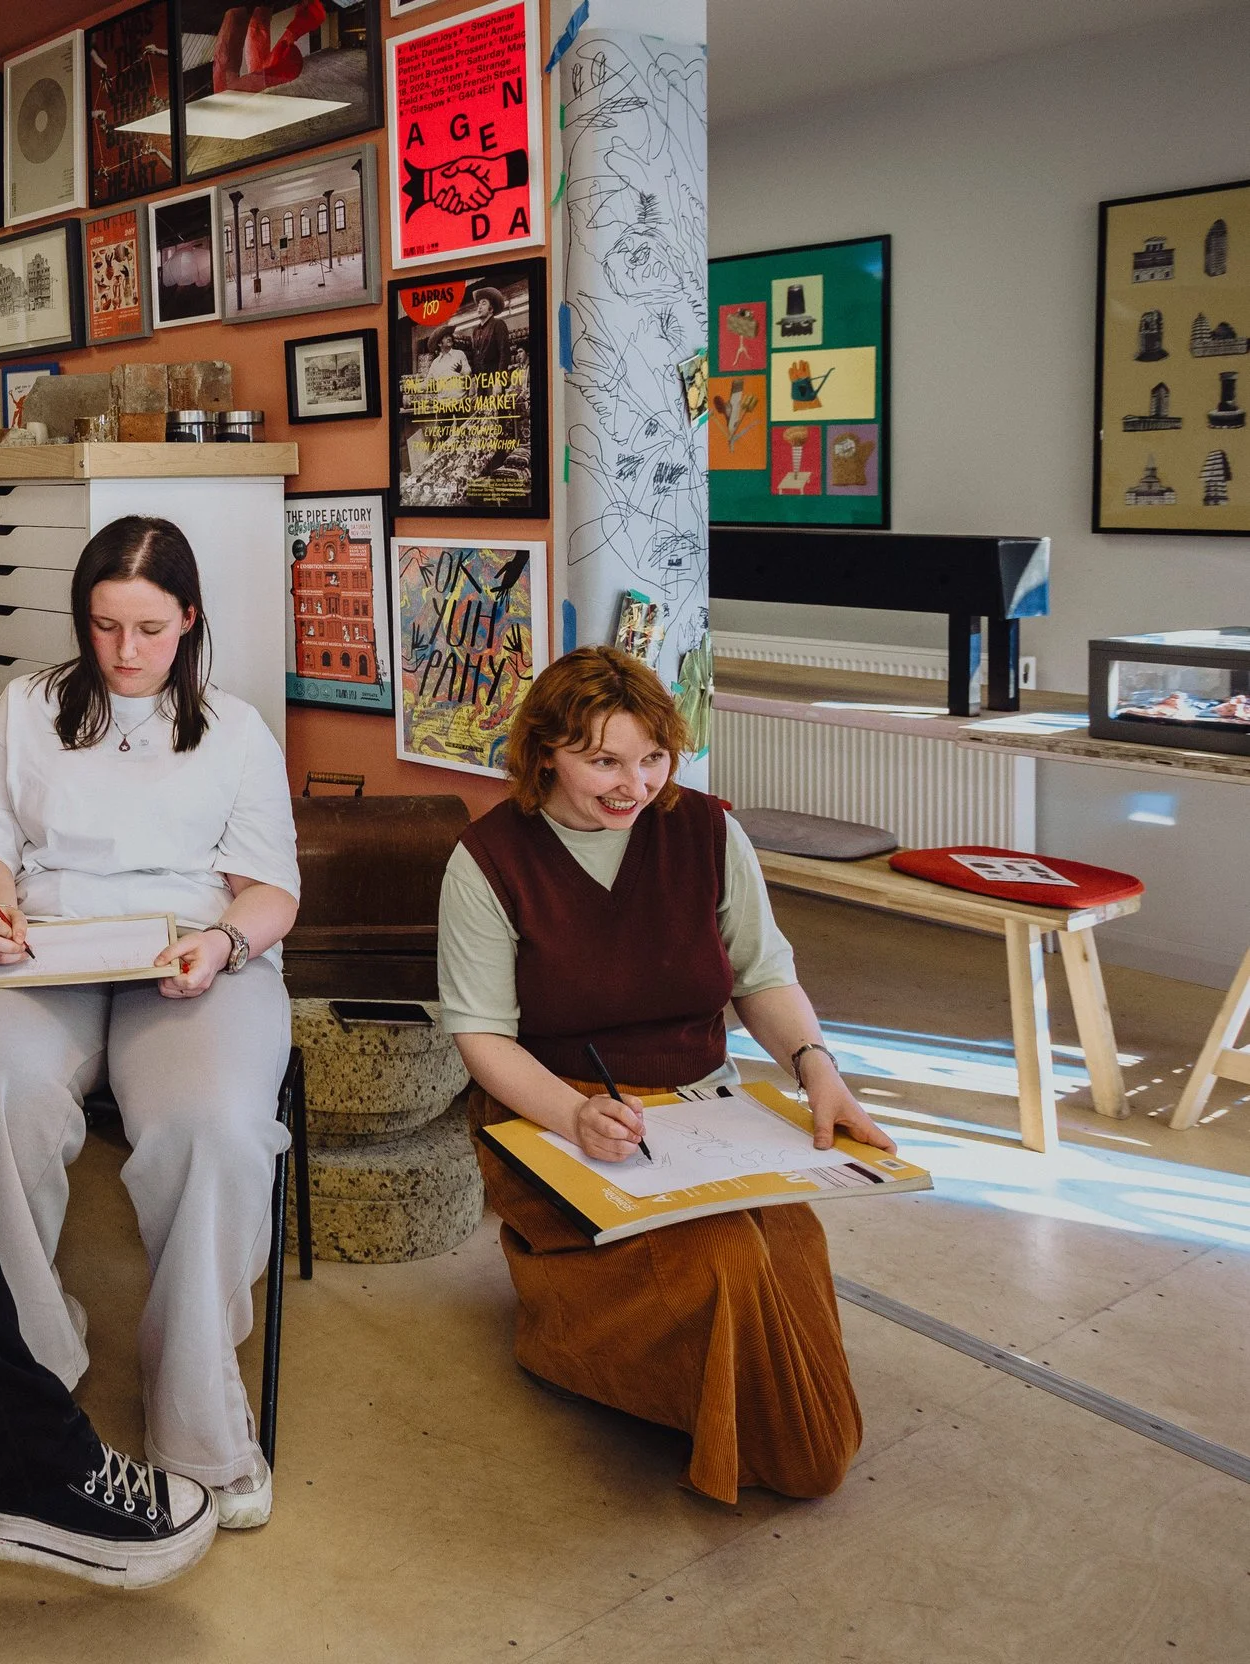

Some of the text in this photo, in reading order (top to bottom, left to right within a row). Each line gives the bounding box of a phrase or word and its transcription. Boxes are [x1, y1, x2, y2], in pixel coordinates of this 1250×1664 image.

[398, 23, 515, 66] Black Daniels Tamir Amar
[409, 12, 515, 51] William Joys Stephanie
[432, 54, 454, 65] Lewis
[456, 43, 487, 58] Prosser
[499, 31, 526, 44] Music
[399, 78, 408, 87] by
[425, 64, 453, 78] Brooks
[467, 49, 505, 65] Saturday
[507, 42, 526, 53] May
[477, 58, 511, 73] Strange
[399, 96, 420, 107] Field
[463, 74, 492, 89] French
[494, 65, 521, 80] Street
[411, 83, 495, 115] Glasgow G40 4EH
[411, 287, 454, 308] BARRAS
[423, 300, 440, 319] 100
[405, 378, 423, 394] ONE
[474, 370, 508, 389] YEARS
[511, 369, 525, 386] OF
[411, 393, 518, 415] THE BARRAS MARKET
[424, 426, 466, 437] EVERYTHING
[286, 507, 372, 523] THE PIPE FACTORY
[435, 551, 482, 594] OK
[429, 597, 498, 648] YUH
